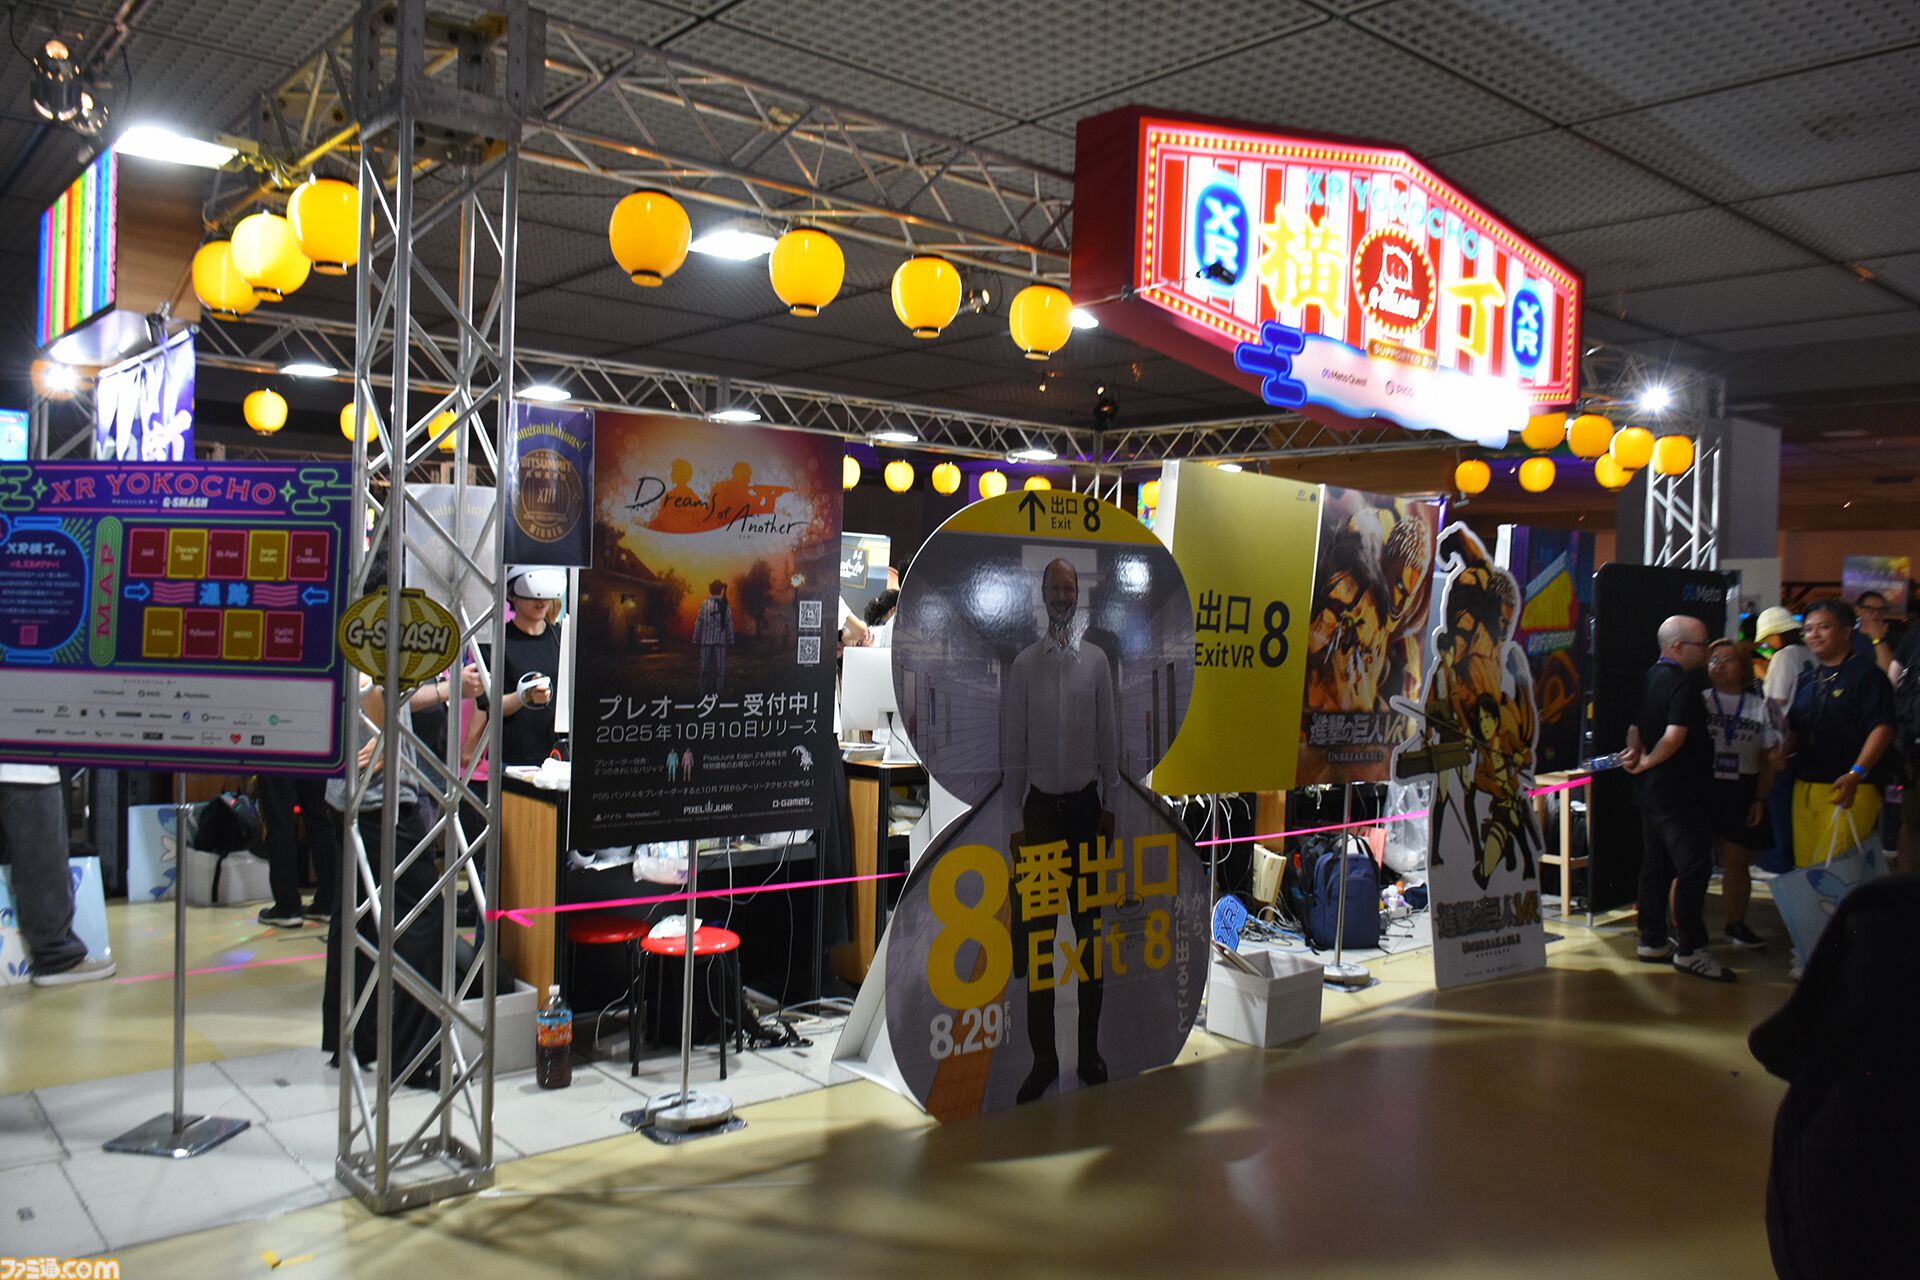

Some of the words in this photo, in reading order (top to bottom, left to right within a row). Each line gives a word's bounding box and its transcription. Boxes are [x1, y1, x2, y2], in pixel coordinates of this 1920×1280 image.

[1203, 197, 1240, 279] XR
[1307, 172, 1344, 206] XR
[1353, 177, 1479, 260] YOKOCHO
[1516, 299, 1540, 356] XR
[52, 477, 96, 504] XR
[106, 472, 277, 506] YOKOCHO
[162, 496, 209, 509] G-SMASH
[625, 476, 717, 522] Dreams
[726, 503, 813, 535] Another
[1051, 496, 1078, 515] 出口
[1051, 516, 1072, 531] Exit
[1083, 498, 1101, 532] 8
[96, 545, 115, 638] MAP
[1196, 589, 1251, 634] 出口
[347, 617, 451, 655] G-SASH
[1259, 600, 1290, 668] 8
[600, 692, 819, 721] プレオーダー受付中!
[596, 719, 818, 743] 2025年10月10日リリース
[927, 844, 1014, 1011] 8
[1015, 832, 1179, 923] 番出口
[1027, 917, 1128, 993] Exit
[1143, 908, 1172, 971] 8
[929, 1003, 1004, 1060] 8.29
[1004, 1000, 1012, 1045] FRI
